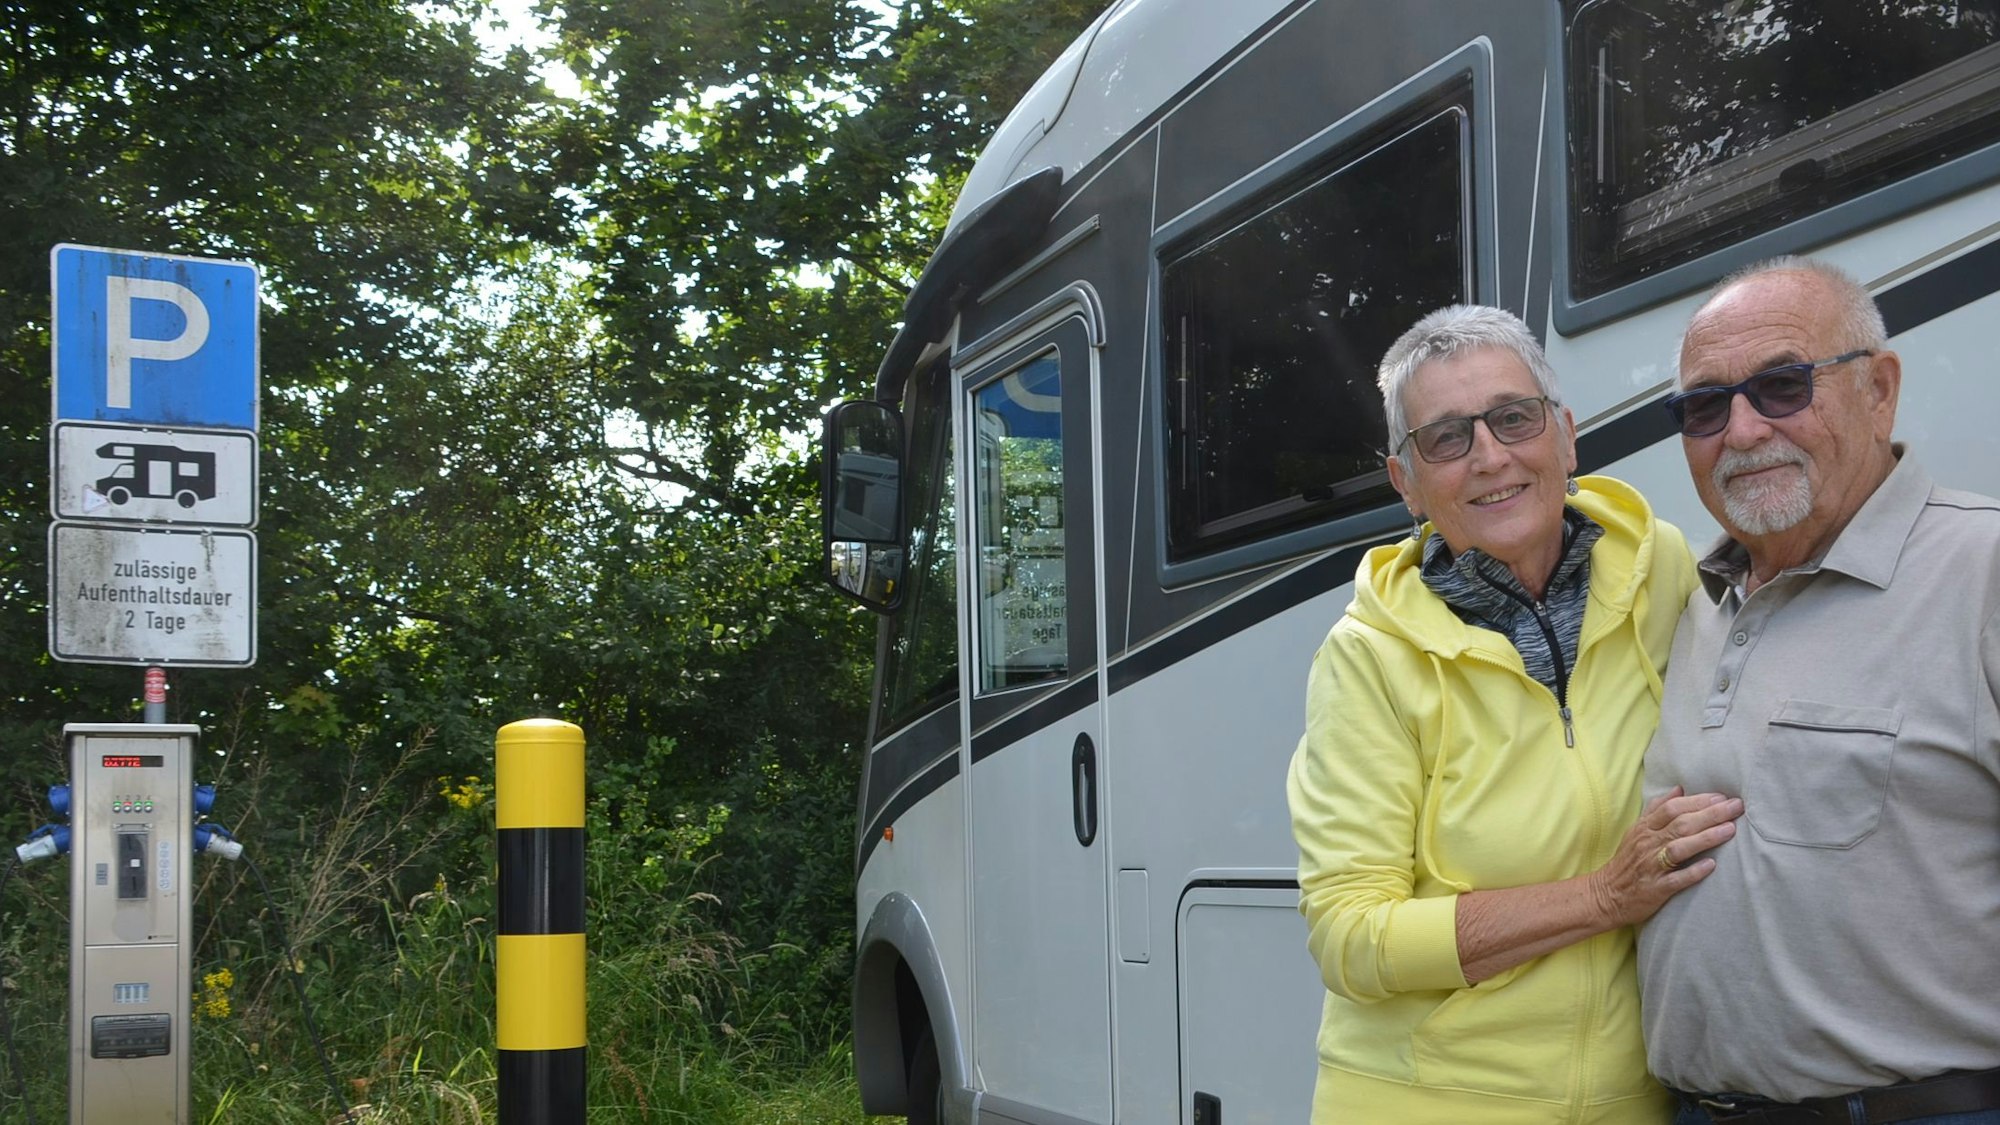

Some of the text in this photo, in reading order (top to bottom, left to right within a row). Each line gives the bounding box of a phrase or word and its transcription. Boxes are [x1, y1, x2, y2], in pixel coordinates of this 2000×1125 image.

[106, 275, 210, 409] P
[114, 560, 197, 584] zulässige
[77, 582, 232, 606] Aufenthaltsdauer
[125, 610, 186, 634] 2 Tage
